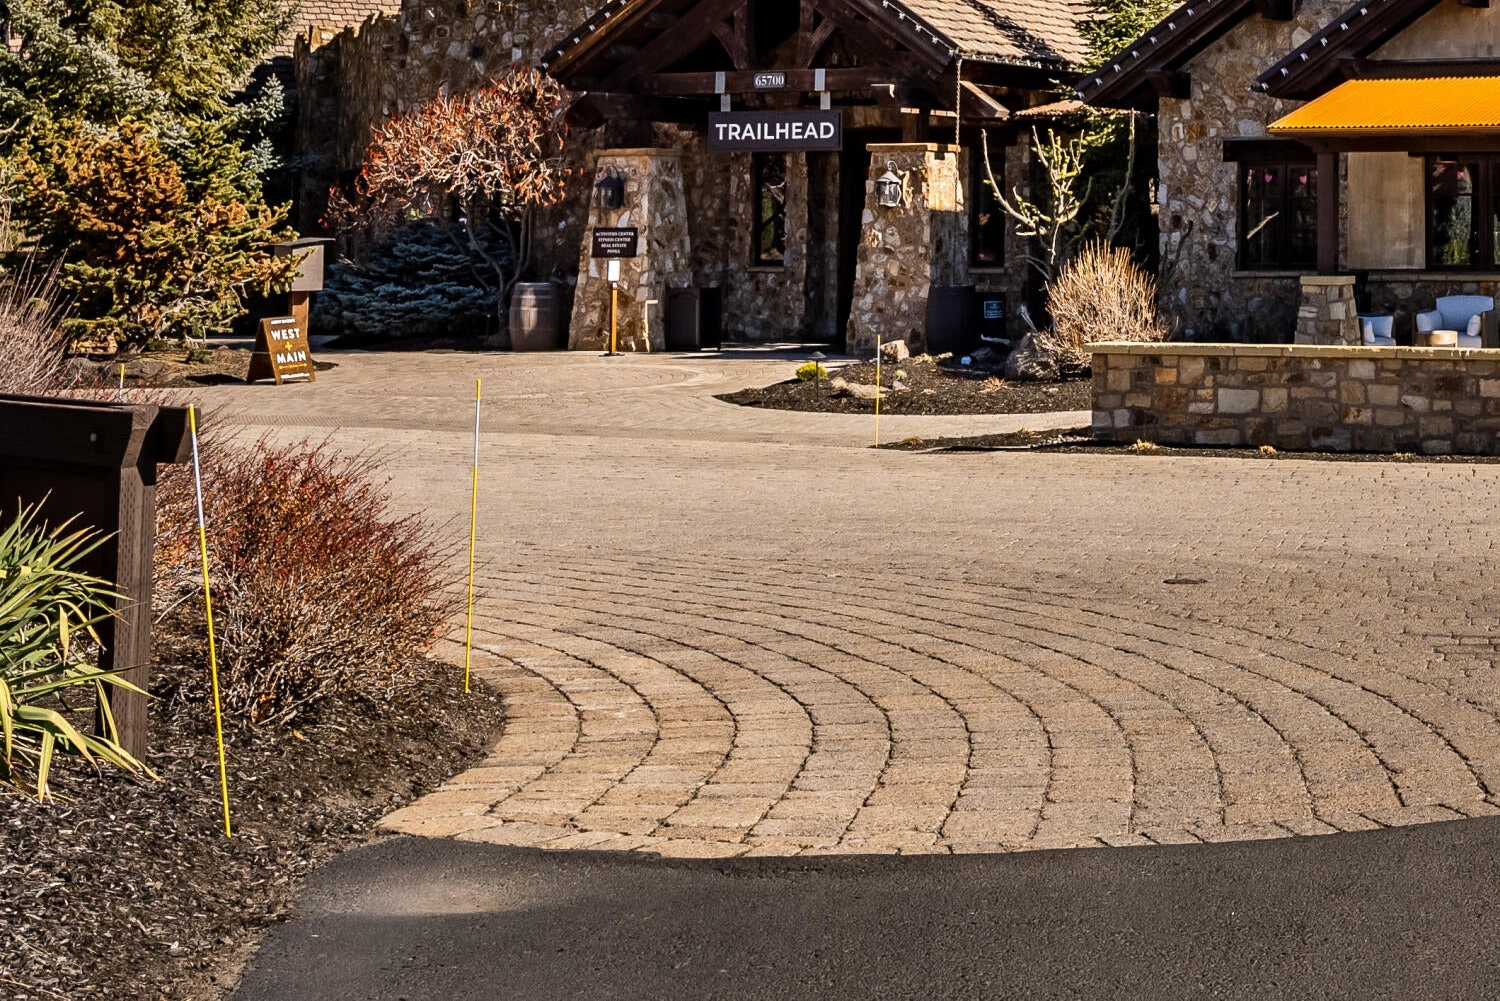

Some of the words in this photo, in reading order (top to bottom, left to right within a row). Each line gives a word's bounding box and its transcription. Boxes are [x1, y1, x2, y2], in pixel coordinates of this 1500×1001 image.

[755, 75, 785, 87] 65700
[715, 122, 835, 141] TRAILHEAD
[270, 328, 300, 341] WEST
[276, 351, 307, 364] MAIN
